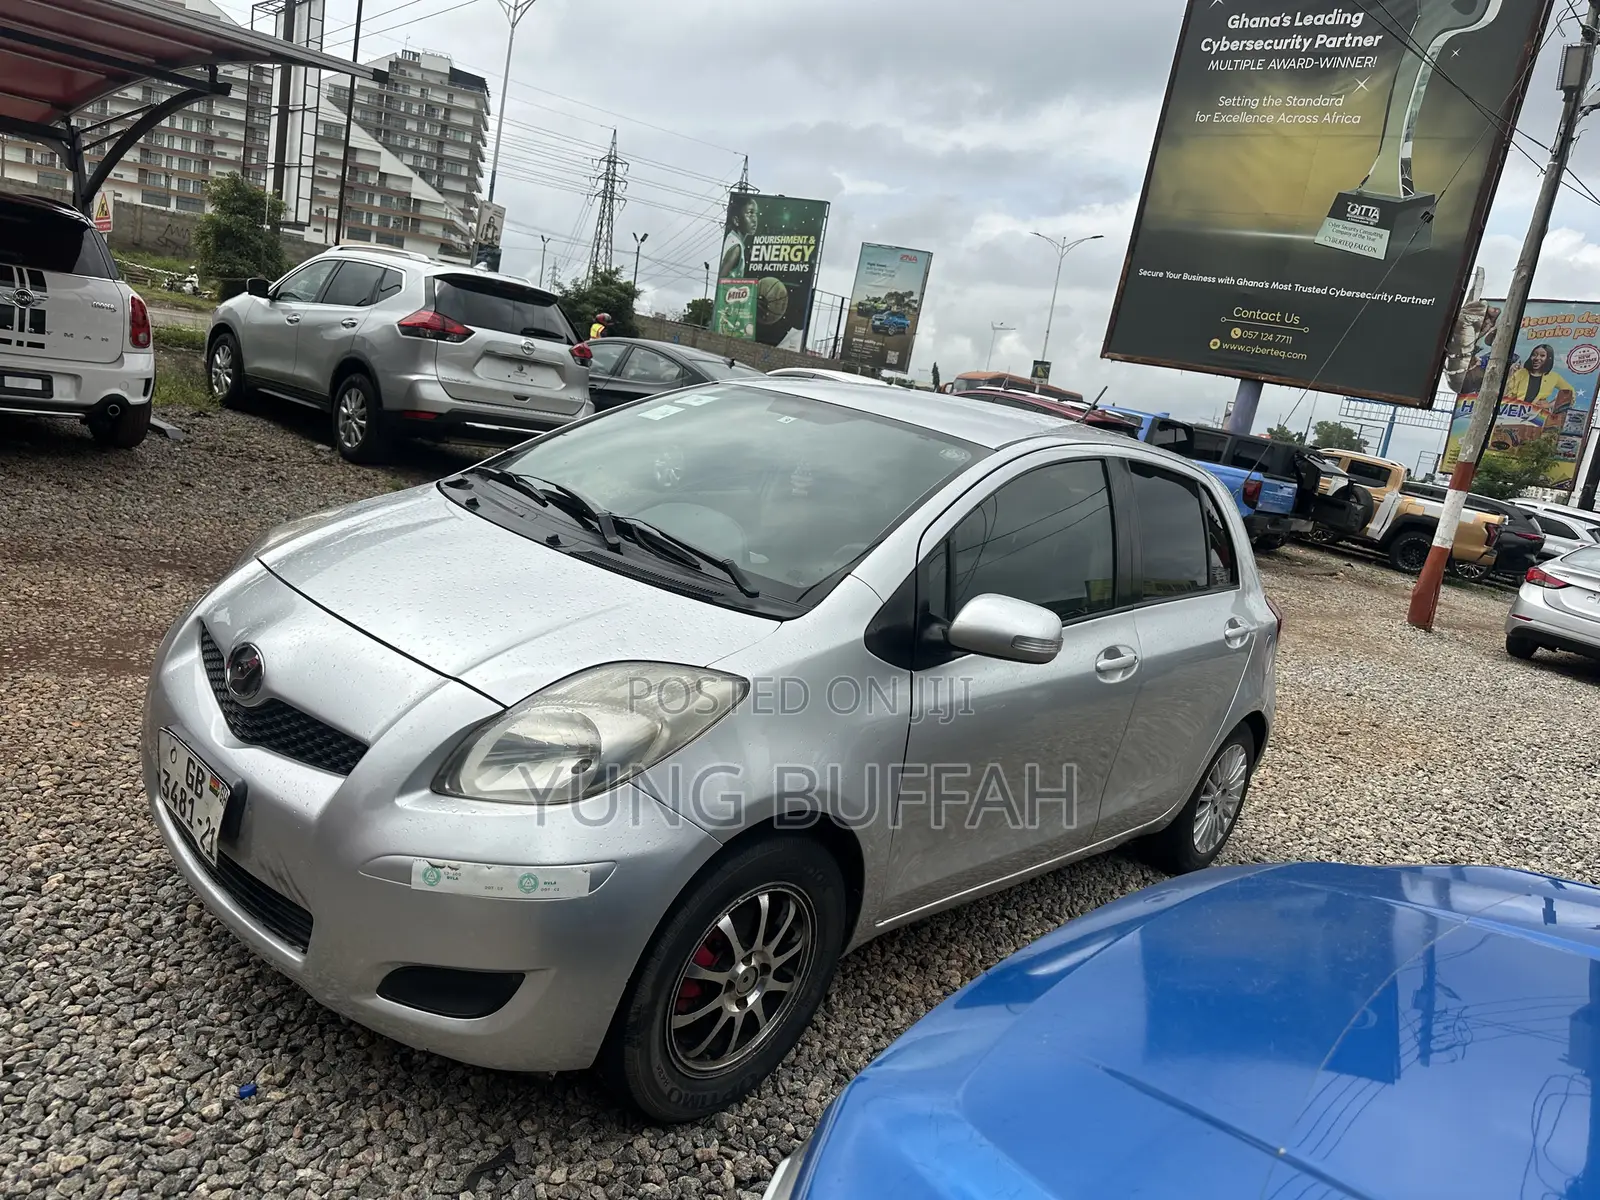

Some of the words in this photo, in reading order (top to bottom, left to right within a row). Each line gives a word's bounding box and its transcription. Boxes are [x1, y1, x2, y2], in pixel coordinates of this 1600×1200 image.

[1228, 13, 1291, 29] Ghana's
[1294, 9, 1364, 27] Leading
[1200, 34, 1313, 54] Cybersecurity
[1314, 33, 1383, 49] Partner
[1207, 58, 1265, 71] MULTIPLE
[1267, 56, 1378, 69] AWARD-WINNER!
[1218, 95, 1259, 109] Setting
[1262, 95, 1282, 107] the
[1285, 94, 1345, 107] Standard
[1195, 111, 1211, 123] for
[1213, 111, 1274, 123] Excellence
[1276, 112, 1318, 124] Across
[1321, 112, 1361, 124] Africa
[1328, 221, 1340, 229] Cyber
[1341, 223, 1359, 233] Security
[1360, 227, 1384, 239] Consulting
[1332, 227, 1351, 238] Company
[753, 235, 808, 245] NOURISHMENT
[808, 236, 816, 245] &
[1324, 236, 1354, 249] CYBERTEQ
[1354, 242, 1377, 253] FALCON
[750, 245, 815, 262] ENERGY
[749, 263, 762, 271] FOR
[763, 263, 788, 272] ACTIVE
[789, 264, 809, 272] DAYS
[727, 291, 748, 300] MILO
[1138, 268, 1164, 278] Secure
[1165, 271, 1182, 280] Your
[1182, 273, 1216, 283] Business
[1217, 276, 1235, 285] with
[1236, 278, 1270, 289] Ghana's
[1270, 281, 1292, 291] Most
[1294, 283, 1328, 295] Trusted
[1328, 287, 1393, 303] Cybersecurity
[1394, 294, 1435, 306] Partner!
[1233, 306, 1281, 323] Contact
[1284, 313, 1301, 325] Us
[1520, 313, 1575, 328] Heaven
[1242, 330, 1259, 340] 057
[1260, 332, 1273, 342] 124
[1275, 334, 1293, 344] 7711
[1527, 326, 1572, 340] baako
[1222, 342, 1307, 361] www.cyberteq.com
[1460, 400, 1533, 418] HVEN
[185, 756, 206, 800] GB
[162, 767, 216, 861] 3481-21
